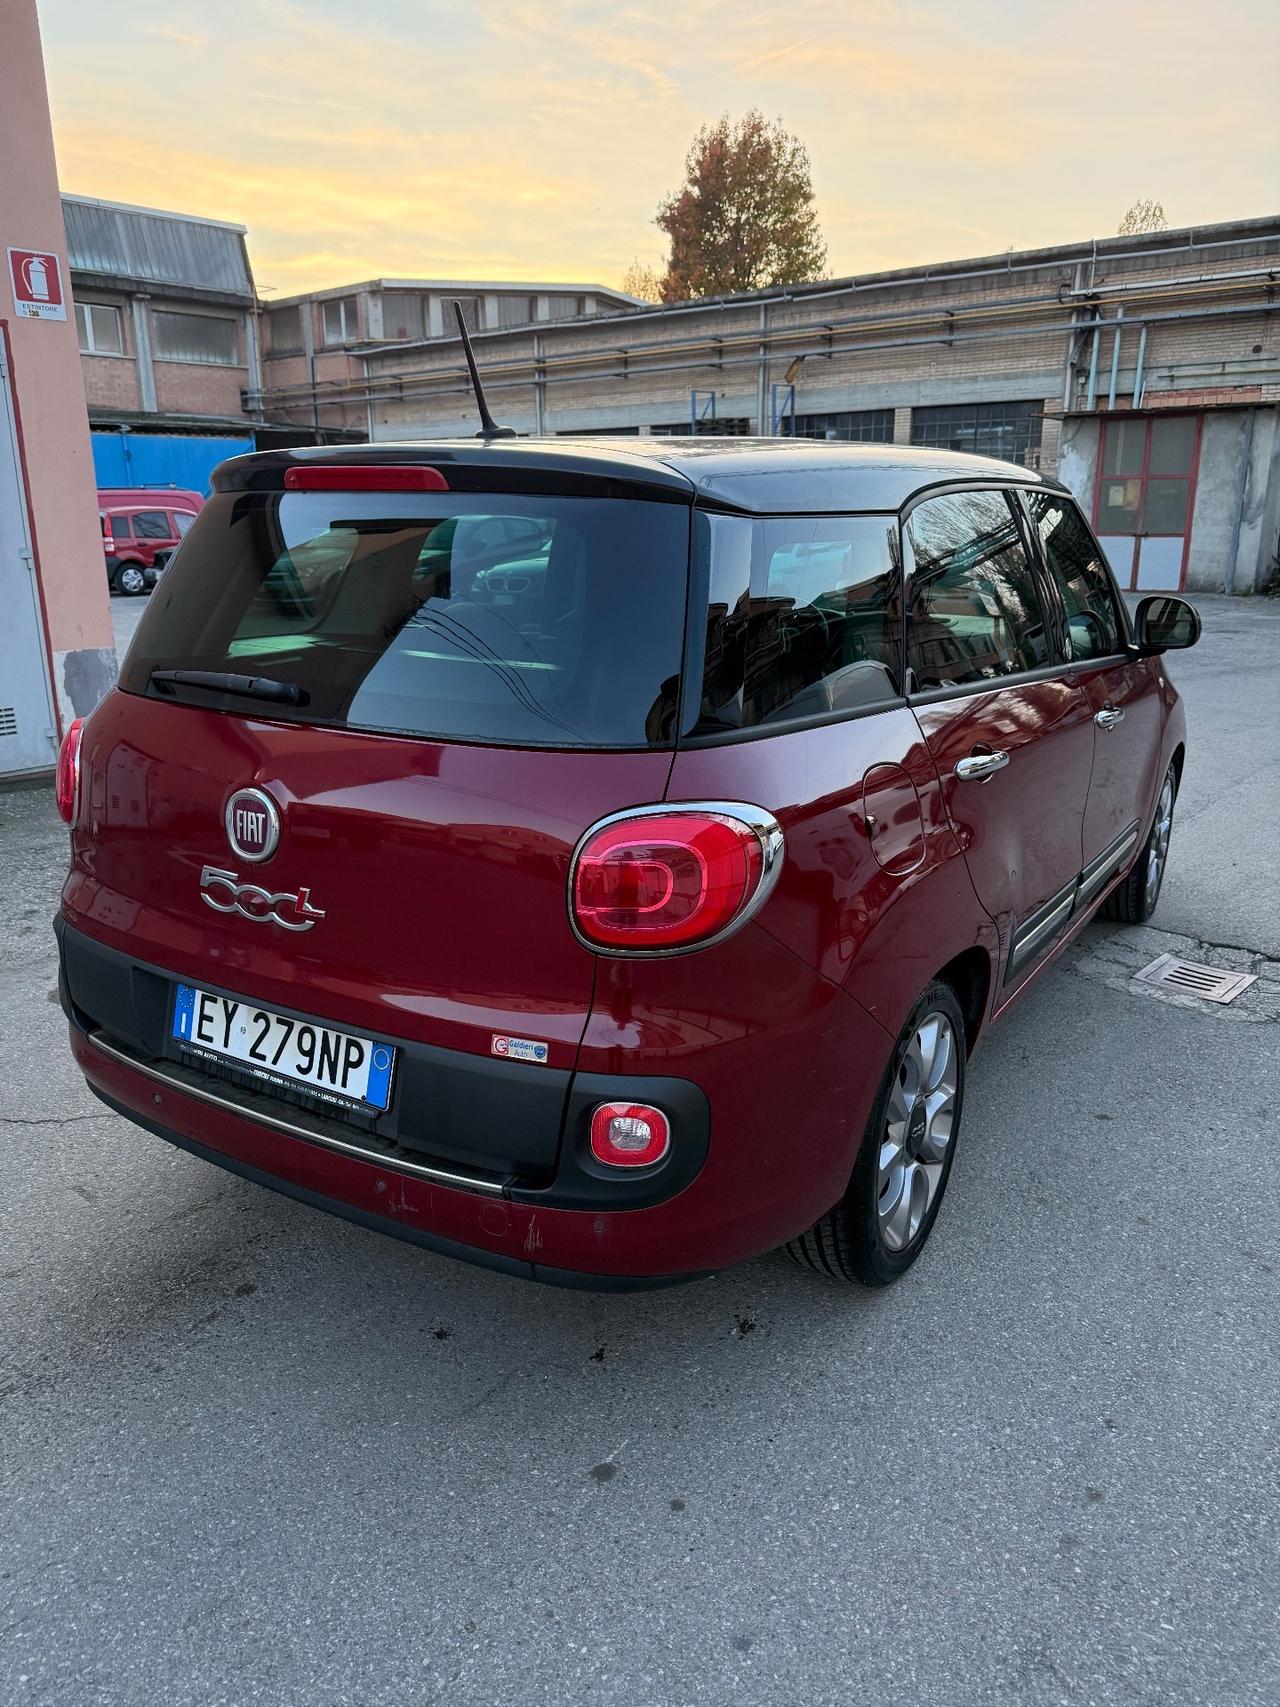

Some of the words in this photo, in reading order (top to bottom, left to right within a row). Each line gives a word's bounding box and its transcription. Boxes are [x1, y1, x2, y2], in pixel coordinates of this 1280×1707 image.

[22, 303, 58, 312] ESTINTORE
[236, 809, 266, 844] FIAT
[197, 993, 239, 1049] EY
[249, 1011, 365, 1089] 279NP
[509, 1040, 534, 1050] Galdieri
